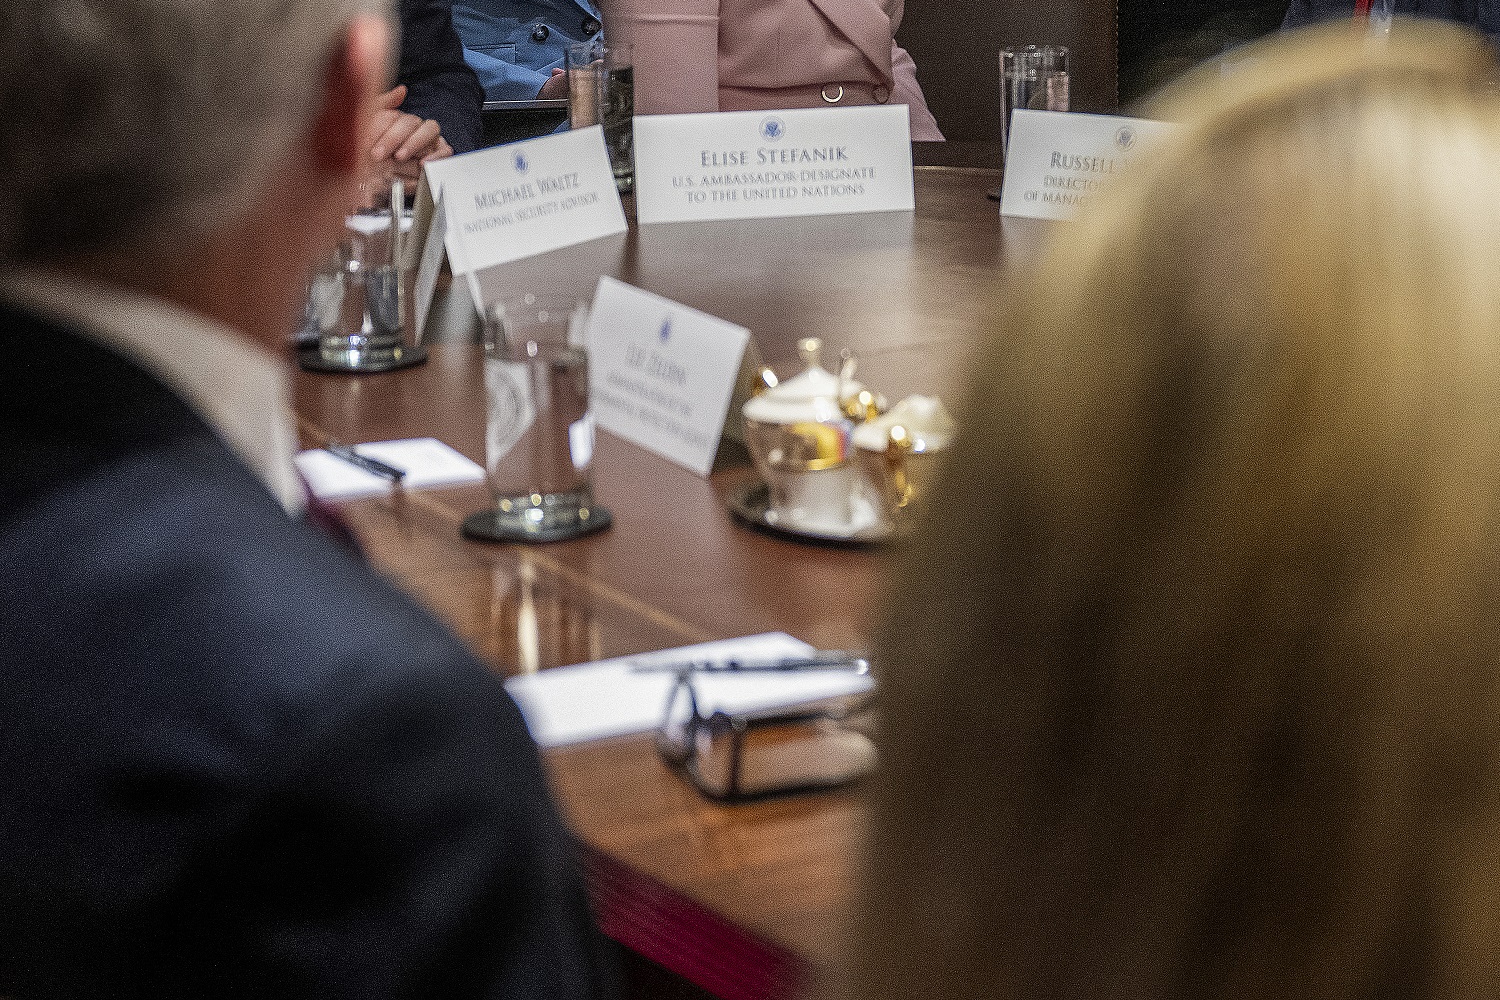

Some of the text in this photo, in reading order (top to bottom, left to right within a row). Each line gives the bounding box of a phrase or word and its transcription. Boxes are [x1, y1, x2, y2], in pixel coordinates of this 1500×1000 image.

[700, 146, 849, 168] ELISE STEFANIK
[687, 183, 866, 203] TO THE UNITED NATIONS
[1043, 194, 1088, 208] MANAG
